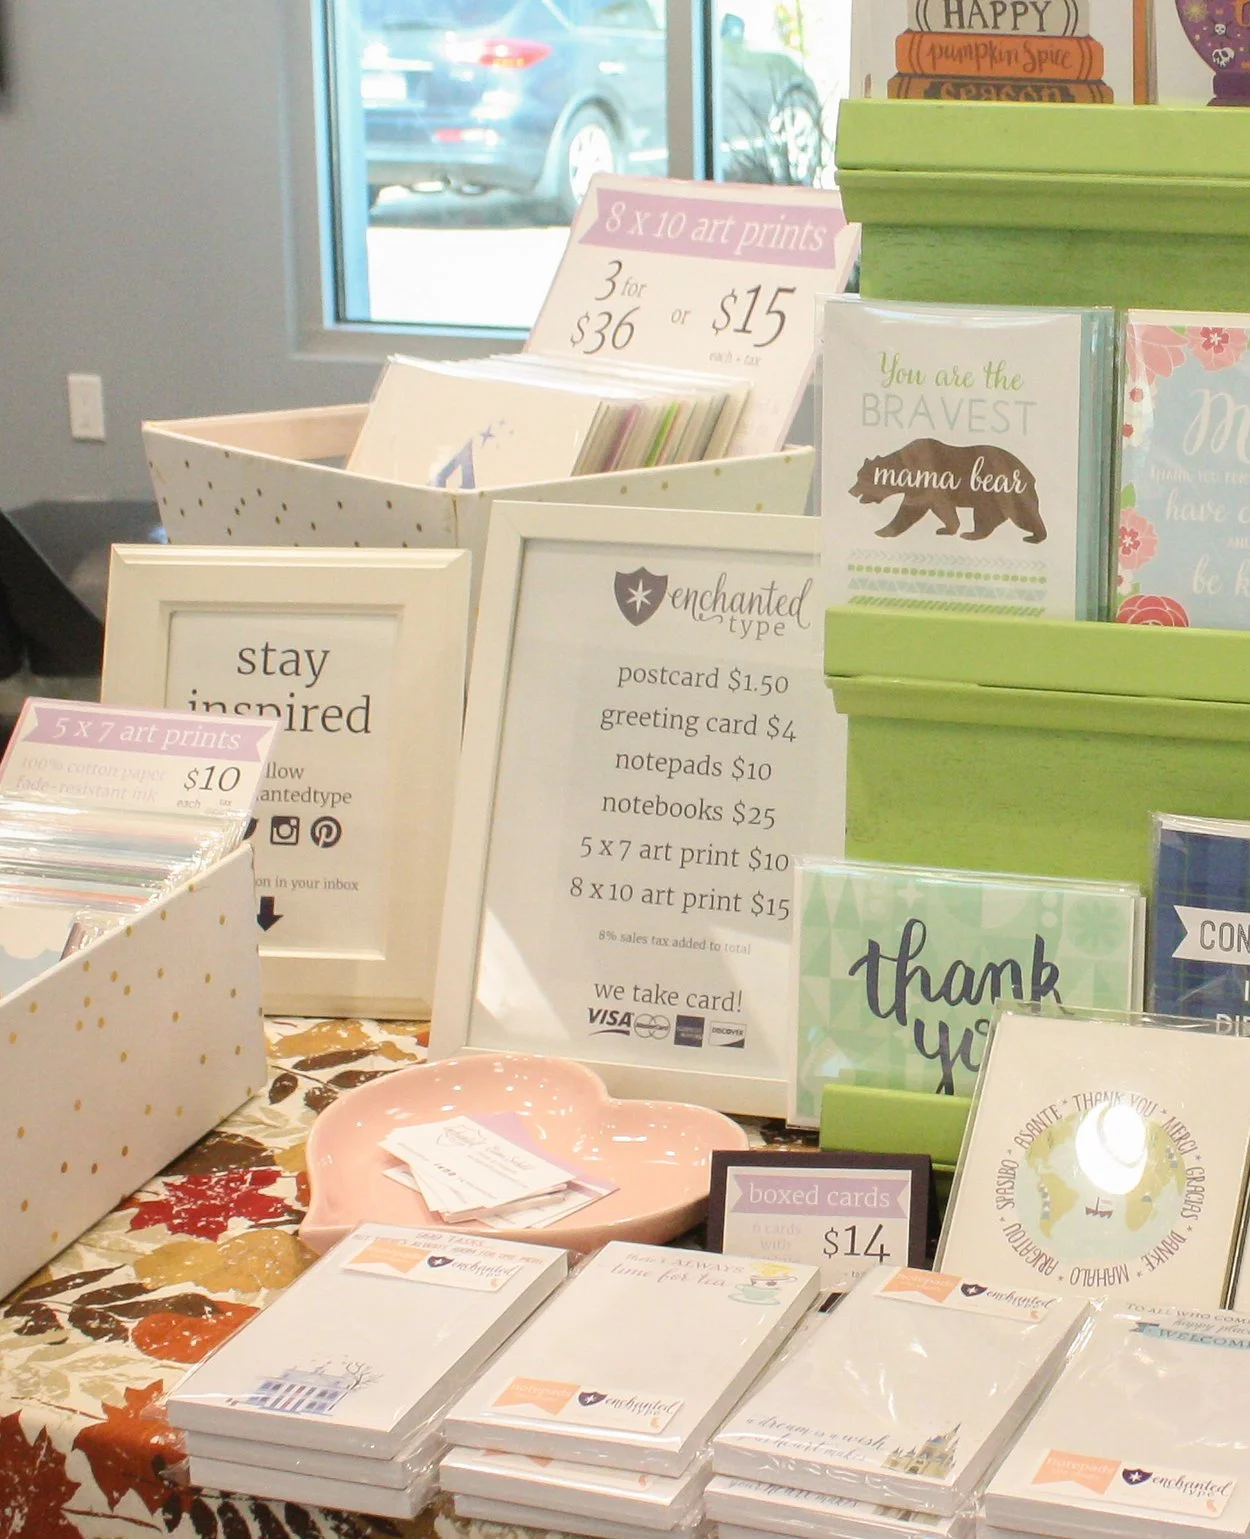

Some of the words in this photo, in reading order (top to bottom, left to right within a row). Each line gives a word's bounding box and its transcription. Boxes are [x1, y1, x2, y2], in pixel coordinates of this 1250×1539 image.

[944, 0, 1051, 32] HAPPY
[926, 40, 1019, 71] pumpkin
[606, 201, 627, 233] 8
[653, 211, 687, 240] 10
[691, 214, 736, 245] art
[734, 215, 827, 255] prints
[595, 260, 622, 301] 3
[621, 275, 647, 299] for
[570, 306, 641, 355] $36
[671, 306, 690, 325] or
[712, 284, 797, 348] $15
[878, 350, 929, 392] You
[935, 365, 975, 390] are
[983, 352, 1024, 392] the
[862, 392, 1037, 436] BRAVEST
[872, 464, 961, 491] mama
[970, 455, 1028, 495] bear
[1165, 488, 1228, 522] have
[1191, 553, 1224, 596] be
[667, 572, 813, 630] enchanted
[728, 616, 786, 640] type
[237, 641, 330, 688] stay
[617, 664, 720, 690] postcard
[728, 667, 790, 697] $1.50
[53, 717, 71, 738] 5
[98, 722, 115, 743] 7
[119, 724, 159, 745] art
[160, 725, 242, 751] prints
[600, 706, 700, 737] greeting
[706, 714, 758, 738] card
[766, 715, 797, 744] $4
[183, 765, 241, 792] $10
[615, 751, 723, 780] notepads
[731, 754, 773, 782] $10
[601, 795, 724, 822] notebooks
[732, 799, 777, 831] $25
[579, 835, 593, 858] 5
[618, 840, 632, 861] 7
[639, 841, 673, 861] art
[679, 844, 740, 869] print
[748, 845, 790, 872] $10
[275, 876, 288, 888] in
[291, 879, 321, 892] your
[323, 876, 359, 891] inbox
[569, 876, 584, 898] 8
[609, 882, 634, 902] 10
[641, 885, 676, 907] art
[681, 887, 743, 915] print
[750, 891, 791, 922] $15
[599, 929, 617, 941] 8%
[620, 932, 648, 944] sales
[650, 935, 669, 947] tax
[671, 938, 706, 950] added
[709, 941, 721, 952] to
[724, 943, 751, 955] total
[848, 918, 1075, 1027] thank
[594, 983, 625, 1001] we
[633, 983, 680, 1006] take
[686, 989, 744, 1013] card!
[587, 1007, 632, 1028] VISA
[913, 1017, 990, 1096] yo
[1130, 1094, 1158, 1118] YOU
[1013, 1103, 1063, 1150] ASANTE
[1160, 1116, 1198, 1155] MERCI
[749, 1182, 819, 1206] boxed
[826, 1186, 891, 1208] cards
[995, 1159, 1019, 1210] SPASIBO
[1180, 1166, 1205, 1221] GRACIAS
[822, 1223, 891, 1263] $14
[1002, 1222, 1059, 1276] ARIGATOU
[1140, 1229, 1187, 1272] DANKE
[669, 1258, 746, 1274] ALWAYS
[1069, 1263, 1130, 1287] MAHALO
[1151, 1474, 1232, 1498] enchanted
